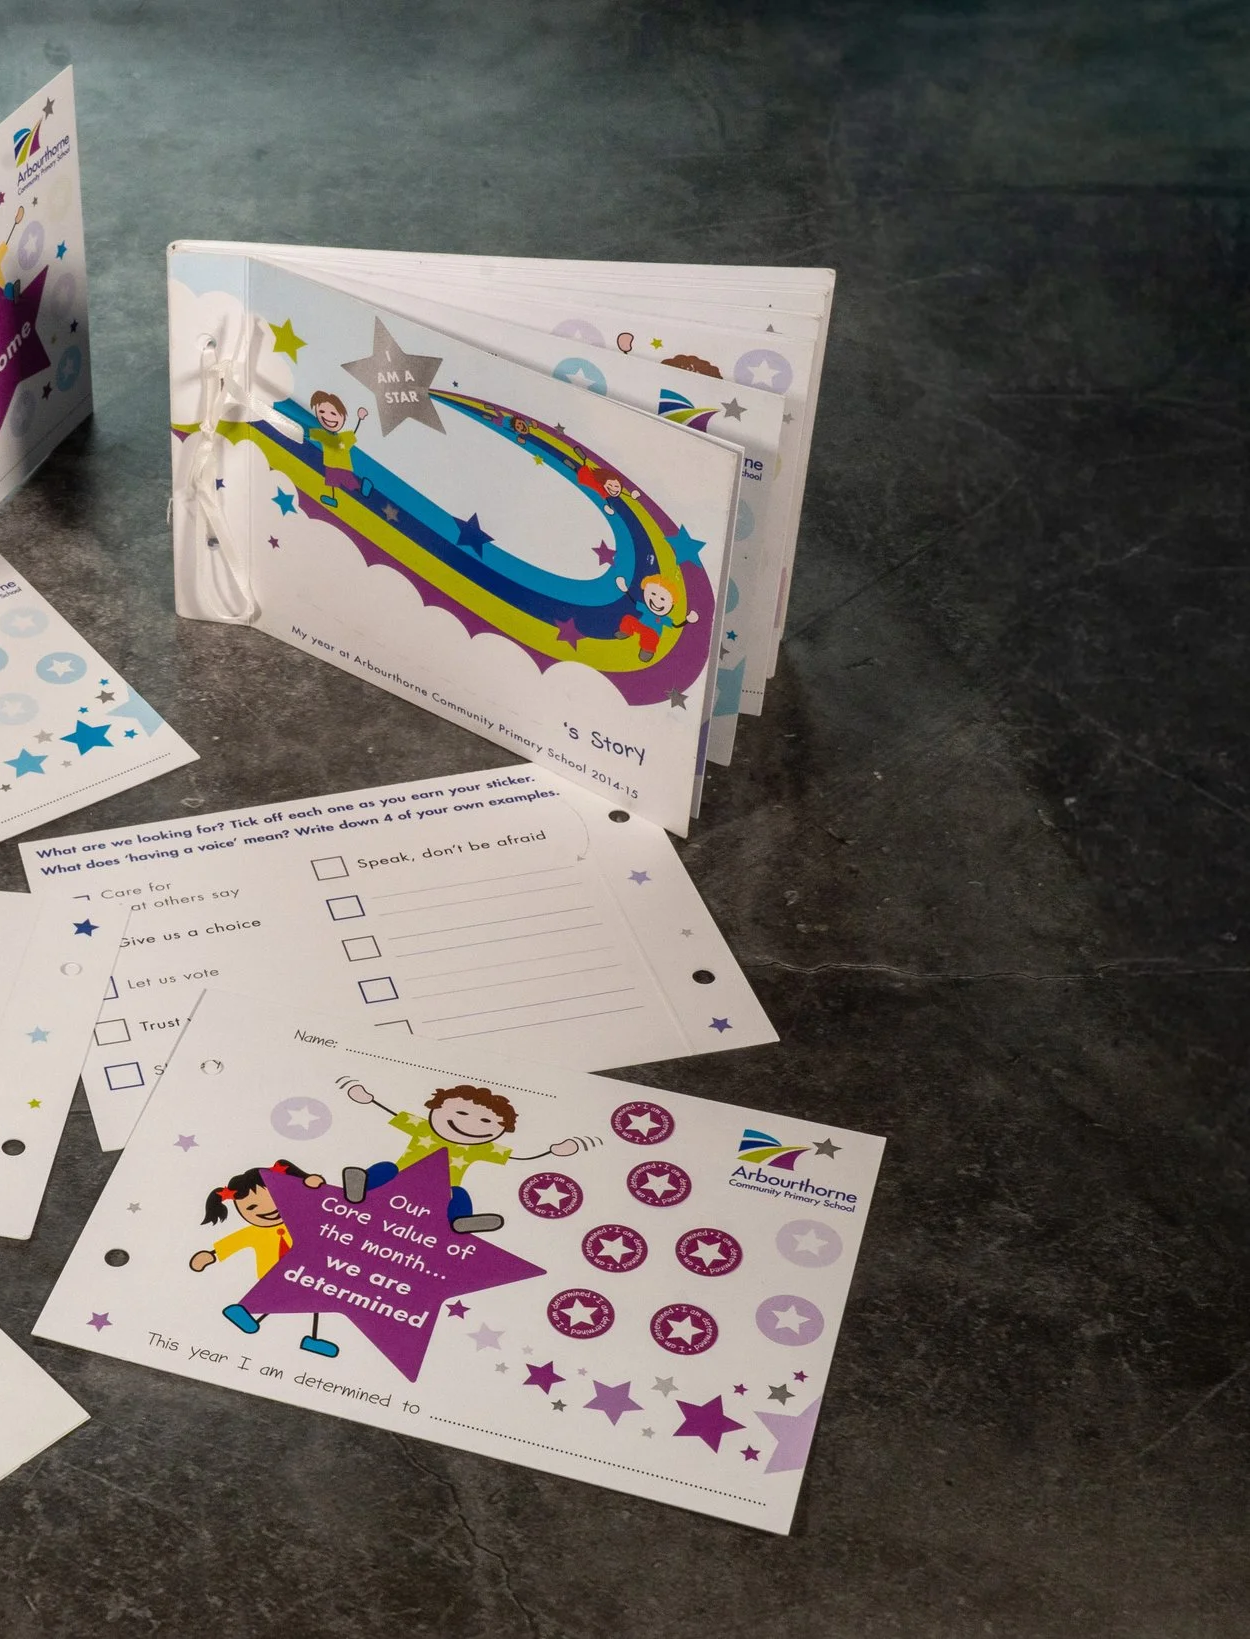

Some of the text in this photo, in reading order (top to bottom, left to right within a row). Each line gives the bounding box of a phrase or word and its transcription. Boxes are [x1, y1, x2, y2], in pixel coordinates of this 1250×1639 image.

[385, 350, 391, 362] I
[377, 370, 415, 383] AM A
[385, 391, 419, 403] STAR
[291, 625, 639, 800] My year at Arbourthorne Community Primary School 2014-15
[591, 731, 646, 766] Story
[36, 775, 536, 860] What are we looking for? Tick off each one as you earn your sticker.
[41, 863, 81, 877] What
[86, 857, 120, 870] does
[183, 846, 193, 855] a
[244, 830, 290, 845] mean?
[294, 823, 334, 837] Write
[339, 817, 379, 831] down
[384, 813, 393, 823] 4
[398, 810, 412, 820] of
[416, 804, 449, 820] your
[453, 801, 484, 812] own
[489, 789, 560, 807] examples.
[357, 853, 415, 869] Speak,
[469, 839, 490, 851] be
[497, 830, 547, 847] afraid
[101, 882, 172, 900] Care for
[154, 887, 240, 908] others say
[163, 931, 181, 941] us
[188, 928, 198, 937] a
[205, 919, 261, 935] choice
[128, 968, 219, 990] Let us vote
[139, 1017, 180, 1032] Trust
[294, 1029, 338, 1049] Name:
[728, 1178, 856, 1213] Community Primary School
[731, 1165, 858, 1204] Arbourthorne
[389, 1195, 431, 1219] Our
[321, 1197, 477, 1261] Core value of
[319, 1222, 447, 1281] the month...
[326, 1255, 412, 1296] we are
[284, 1266, 431, 1330] determined
[148, 1331, 421, 1415] This year I am determined to
